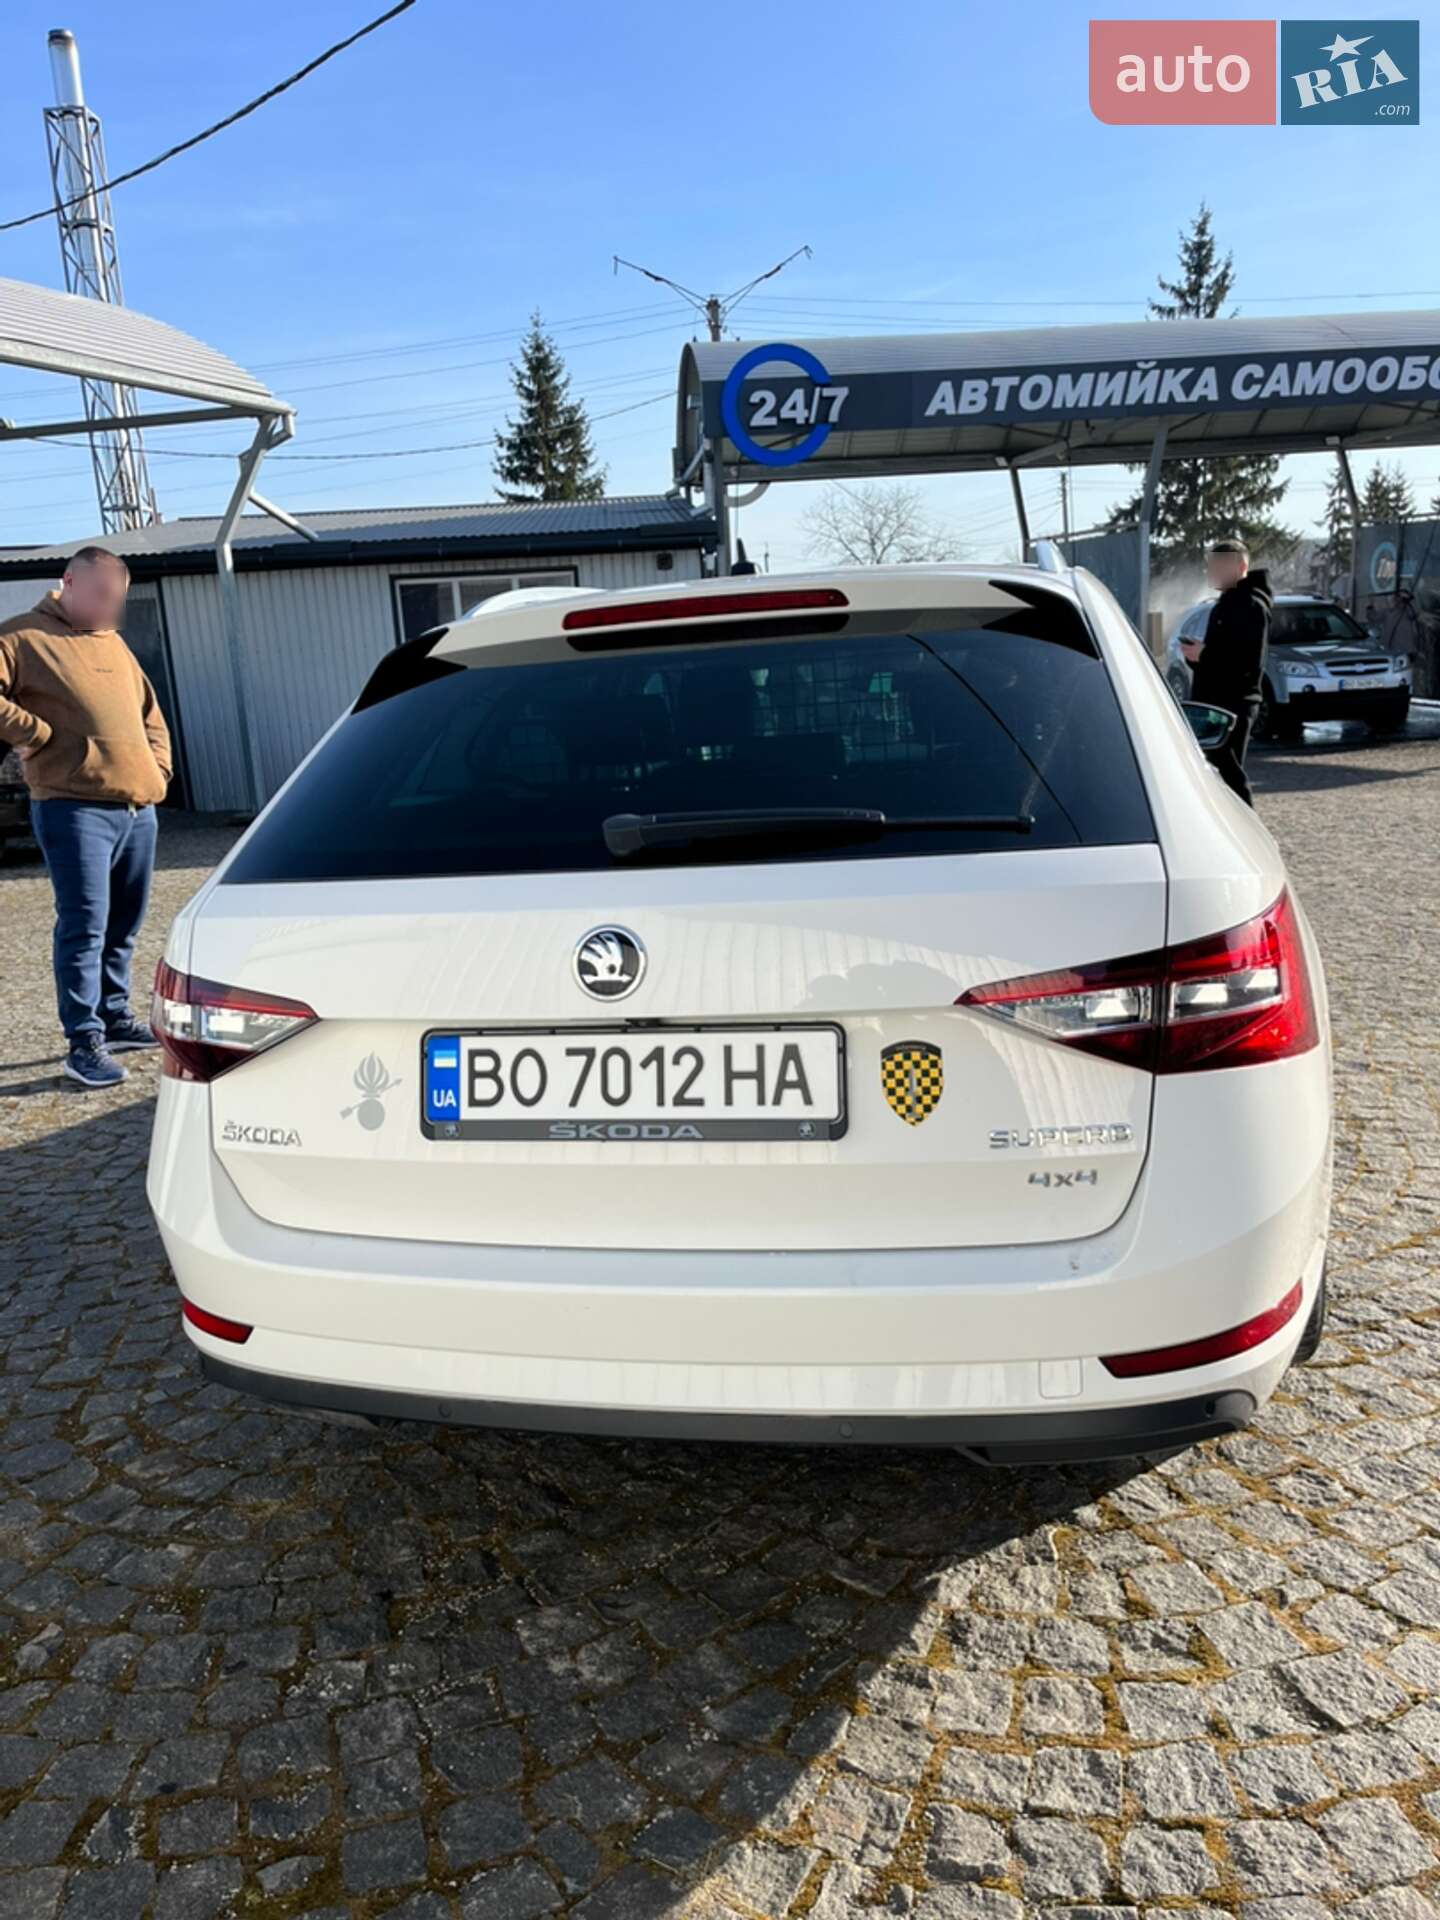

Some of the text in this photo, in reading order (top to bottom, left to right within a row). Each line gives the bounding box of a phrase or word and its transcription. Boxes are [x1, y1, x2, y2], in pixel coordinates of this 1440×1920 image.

[925, 361, 1219, 416] АВТОМИЙКА
[749, 387, 849, 426] 24/7
[467, 1043, 813, 1108] BO 7012 HA
[433, 1089, 457, 1107] UA
[222, 1120, 303, 1147] ŠKODA
[549, 1121, 704, 1139] ŠKODA
[989, 1123, 1134, 1149] SUPERB
